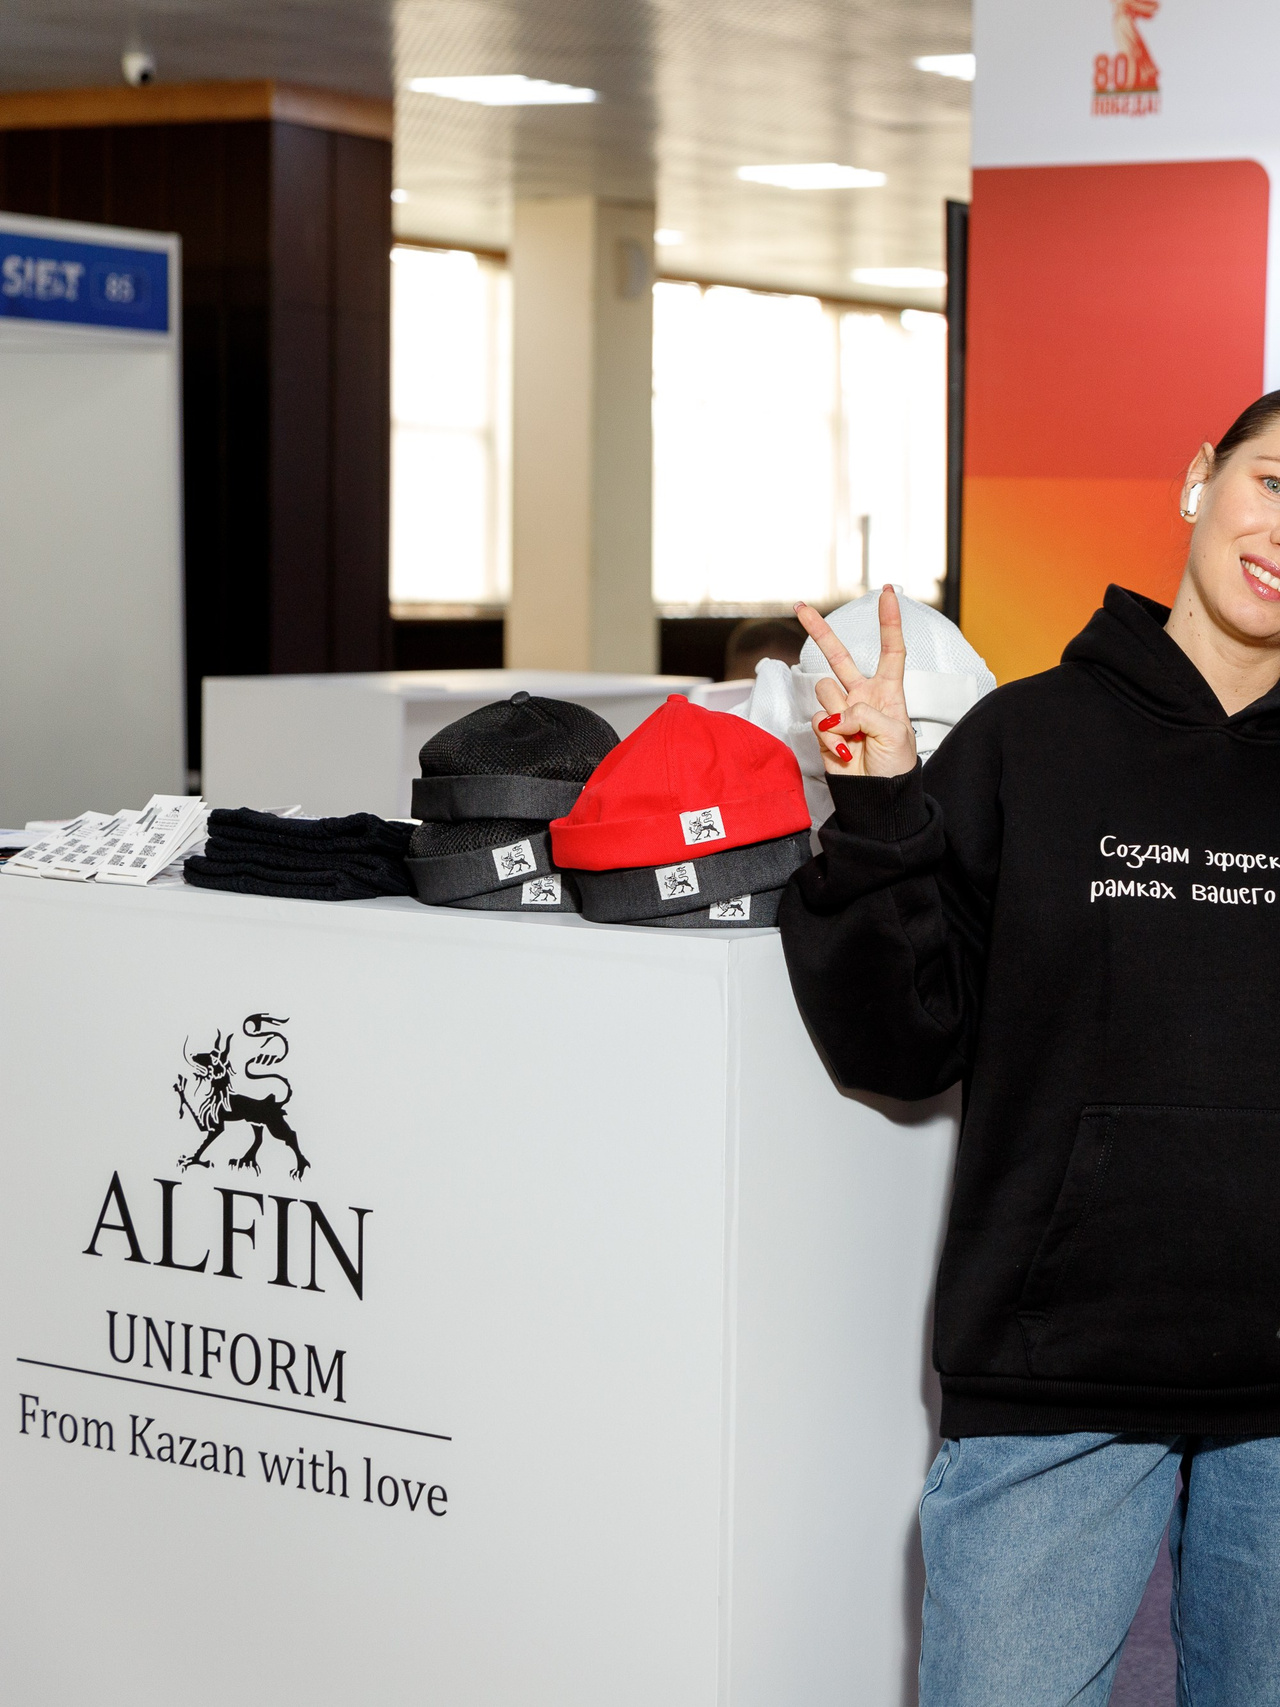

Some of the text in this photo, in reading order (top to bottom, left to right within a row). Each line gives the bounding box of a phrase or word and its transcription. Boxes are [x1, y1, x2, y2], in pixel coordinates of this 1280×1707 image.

[1093, 53, 1129, 93] 80
[1100, 835, 1190, 869] Создам
[1090, 878, 1177, 903] рамках
[1191, 883, 1277, 905] вашего
[82, 1170, 374, 1301] ALFIN
[106, 1310, 347, 1404] UNIFORM
[18, 1393, 449, 1518] From Kazan with love
